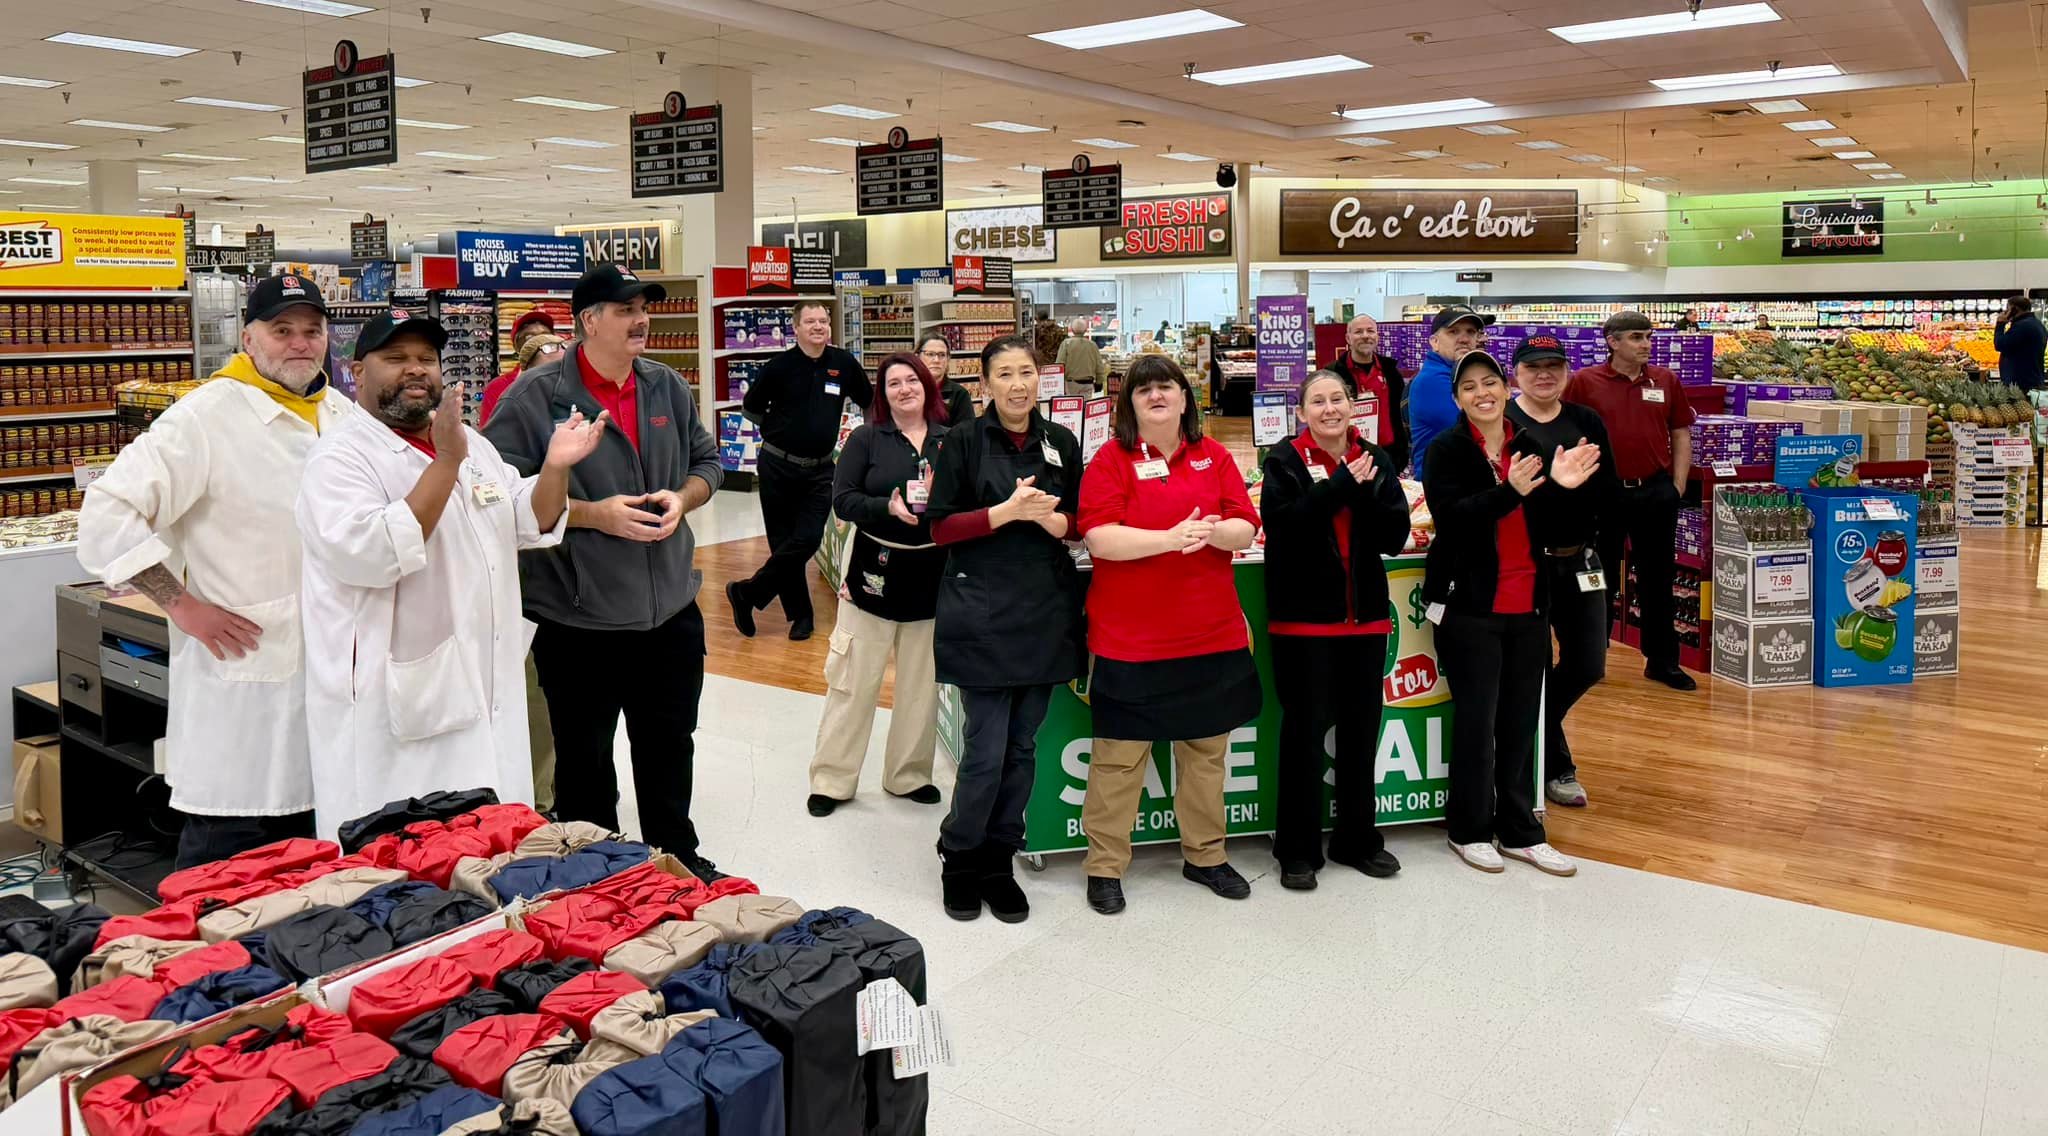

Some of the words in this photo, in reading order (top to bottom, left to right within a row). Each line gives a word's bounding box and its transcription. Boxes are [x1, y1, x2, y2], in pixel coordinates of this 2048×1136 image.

[340, 46, 347, 69] 4
[670, 96, 677, 115] 3
[894, 130, 901, 146] 2
[1079, 158, 1082, 171] 1
[1122, 198, 1208, 228] FRESH
[1793, 207, 1875, 230] Louisiana
[1329, 196, 1377, 249] Ça
[1475, 196, 1535, 238] bon
[0, 230, 53, 245] BEST
[73, 228, 118, 236] Consistently
[954, 224, 1046, 250] CHEESE
[1125, 226, 1205, 254] SUSHI
[1811, 230, 1877, 248] Proud
[0, 247, 53, 258] VALUE
[475, 239, 505, 249] ROUSES
[584, 236, 659, 262] AKERY
[210, 250, 218, 265] &
[461, 248, 520, 264] REMARKABLE
[765, 250, 774, 261] AS
[473, 262, 510, 278] BUY
[751, 262, 788, 273] ADVERTISED
[1842, 535, 1862, 547] 15%
[1922, 567, 1943, 577] $7.99
[1770, 575, 1792, 588] $7.99
[1915, 642, 1946, 651] TAAKA
[1766, 650, 1800, 662] TAAKA
[1391, 662, 1433, 698] For
[1323, 716, 1450, 786] AL
[1059, 726, 1259, 806] SAE
[1406, 791, 1430, 810] OR
[1150, 810, 1176, 831] OR
[1224, 803, 1259, 824] TEN!
[1067, 814, 1087, 839] BU
